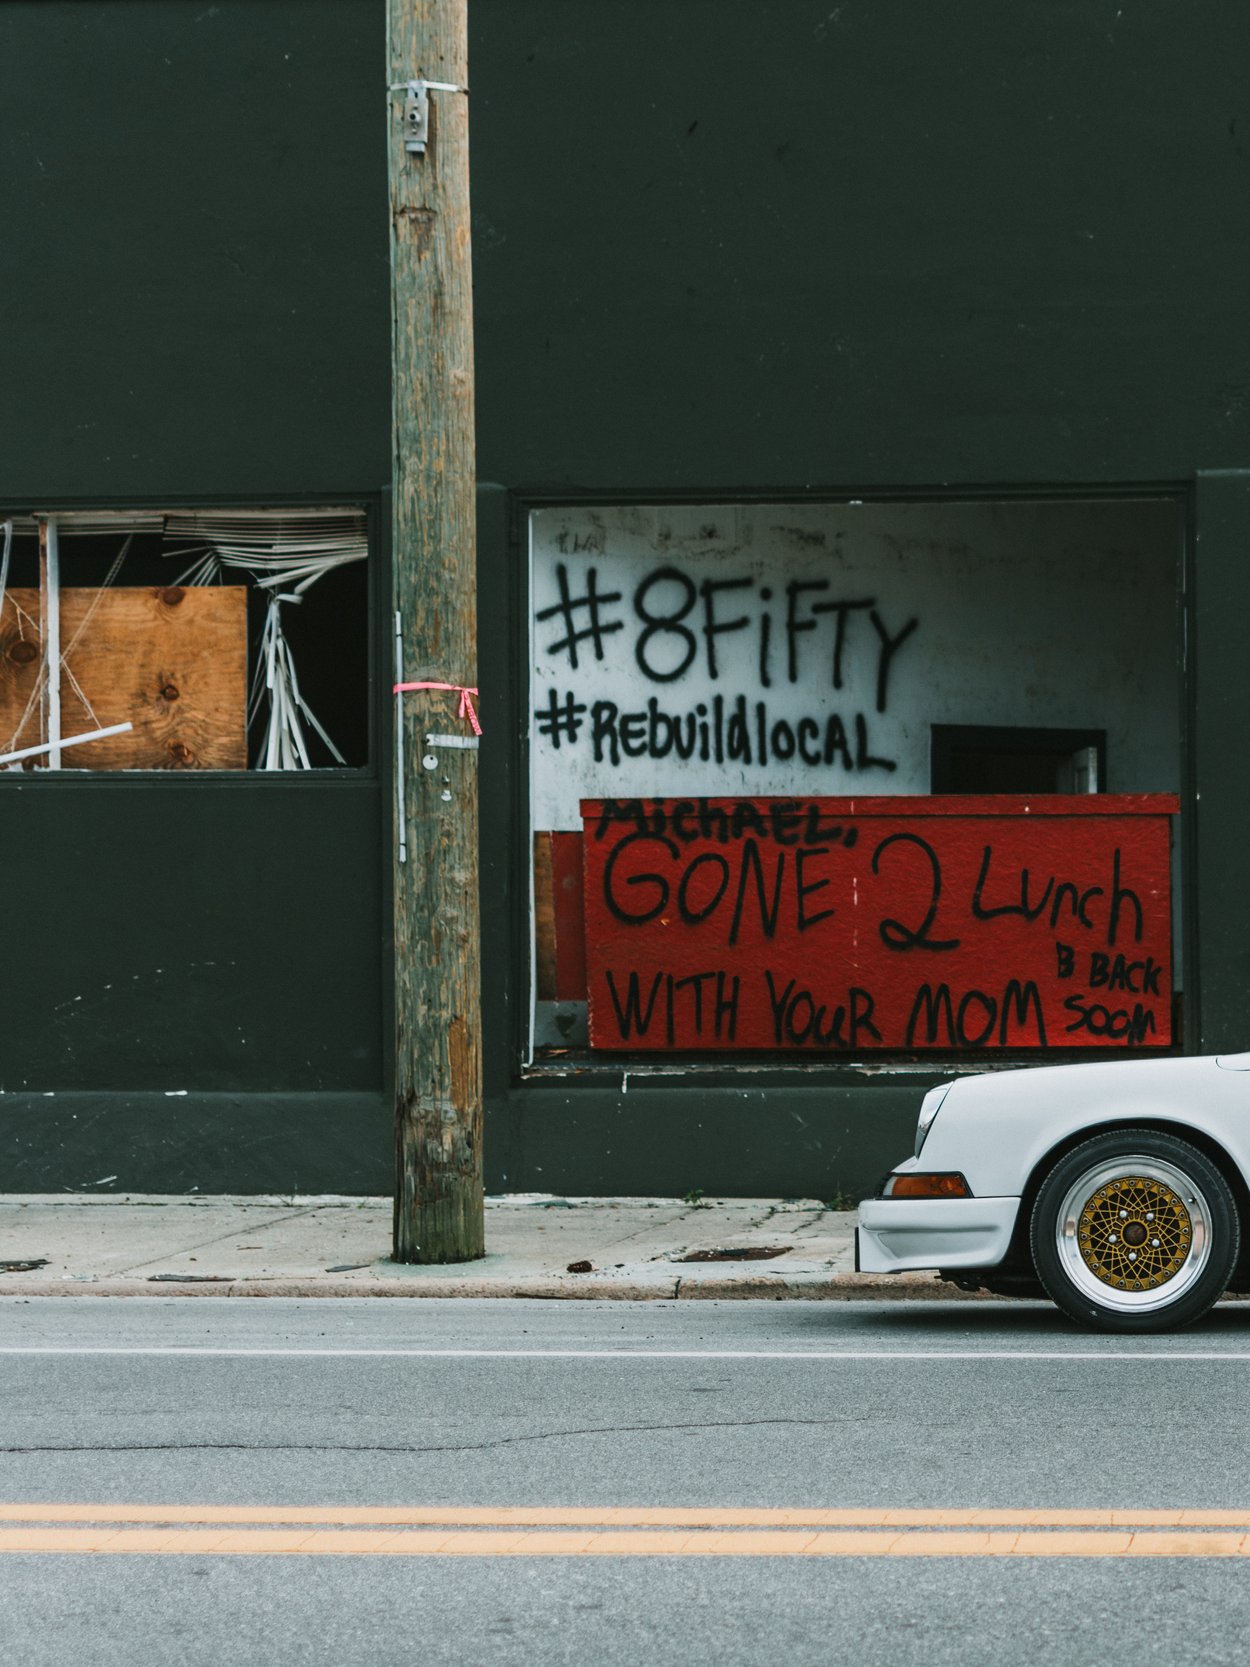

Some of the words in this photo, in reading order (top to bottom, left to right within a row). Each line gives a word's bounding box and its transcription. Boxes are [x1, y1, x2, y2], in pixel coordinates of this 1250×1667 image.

[603, 830, 835, 948] GONE
[871, 832, 961, 951] 2
[971, 845, 1143, 947] Lunch
[1055, 941, 1075, 979] B
[1089, 952, 1163, 996] BACK
[605, 969, 741, 1046] WITH
[904, 979, 1048, 1047] MOM
